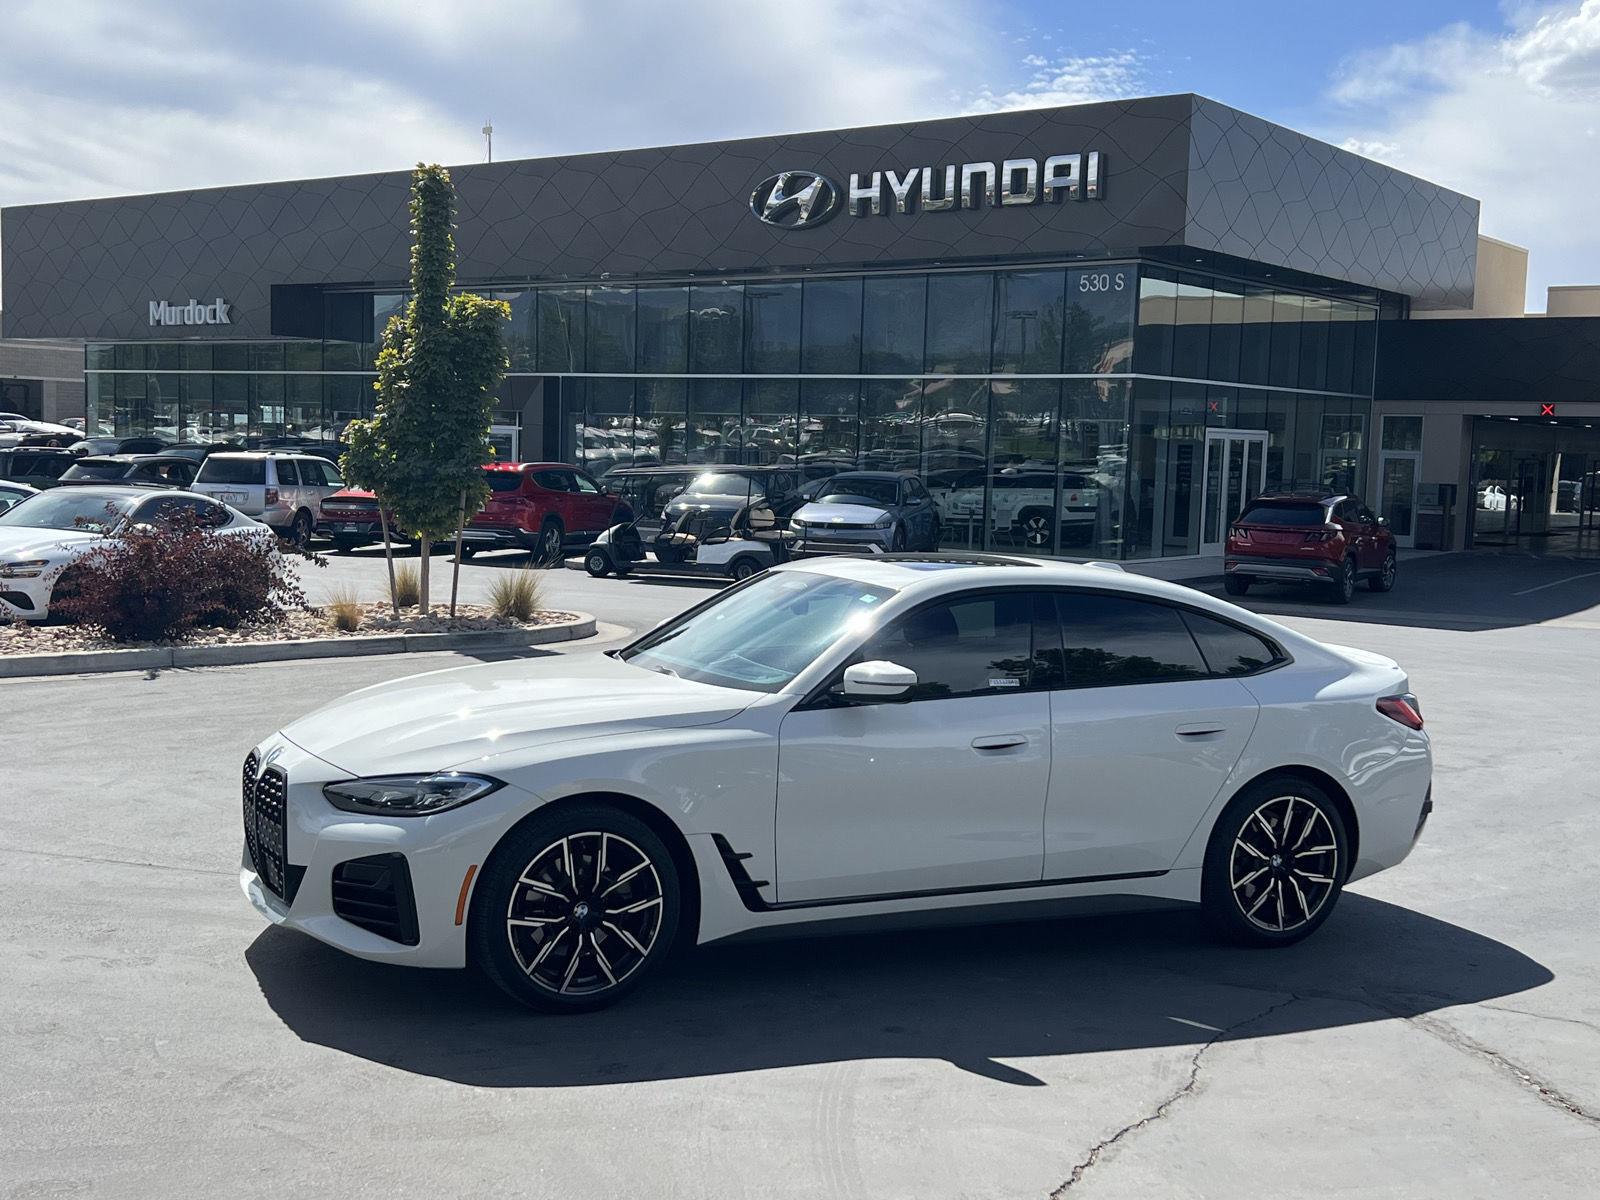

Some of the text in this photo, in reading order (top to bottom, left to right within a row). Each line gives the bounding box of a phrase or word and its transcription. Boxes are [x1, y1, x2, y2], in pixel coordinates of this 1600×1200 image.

[849, 151, 1102, 217] HYUNDAI
[1079, 272, 1125, 292] 530 S
[149, 297, 231, 326] Murdock
